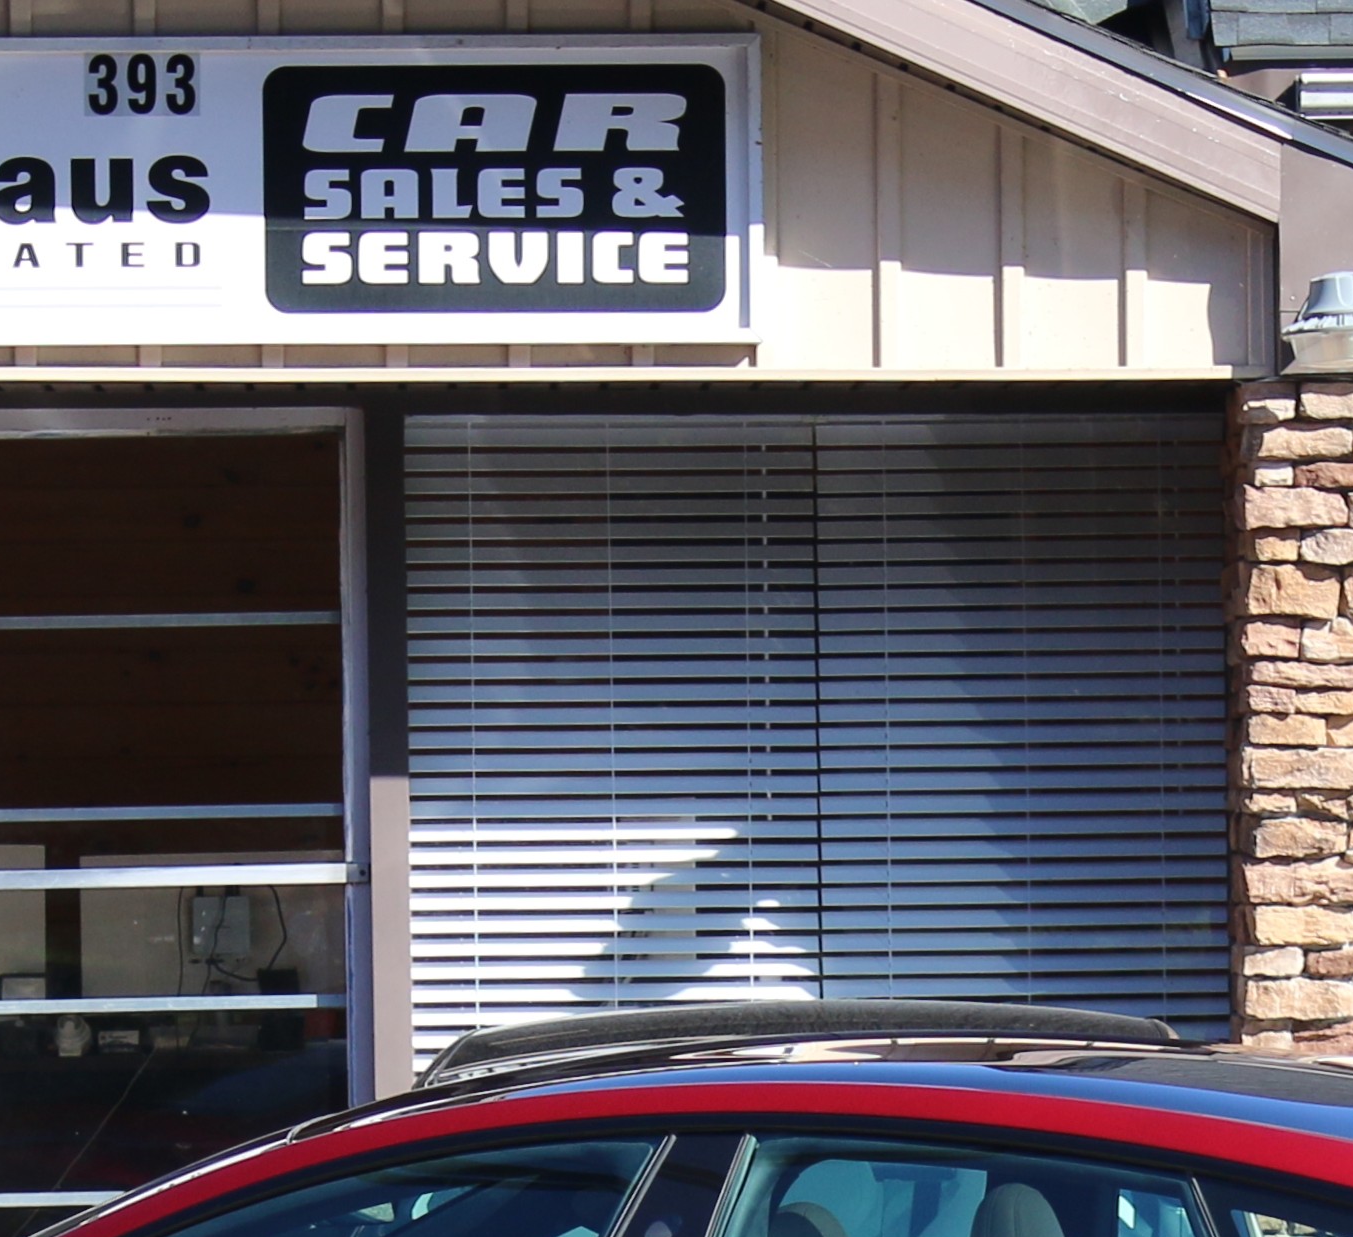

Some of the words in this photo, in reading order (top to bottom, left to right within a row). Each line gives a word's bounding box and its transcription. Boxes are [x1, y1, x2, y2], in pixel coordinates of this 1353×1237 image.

[89, 53, 196, 115] 393
[302, 93, 687, 152] CAR
[304, 168, 584, 219] SALES
[612, 167, 685, 217] &
[301, 231, 689, 285] SERVICE
